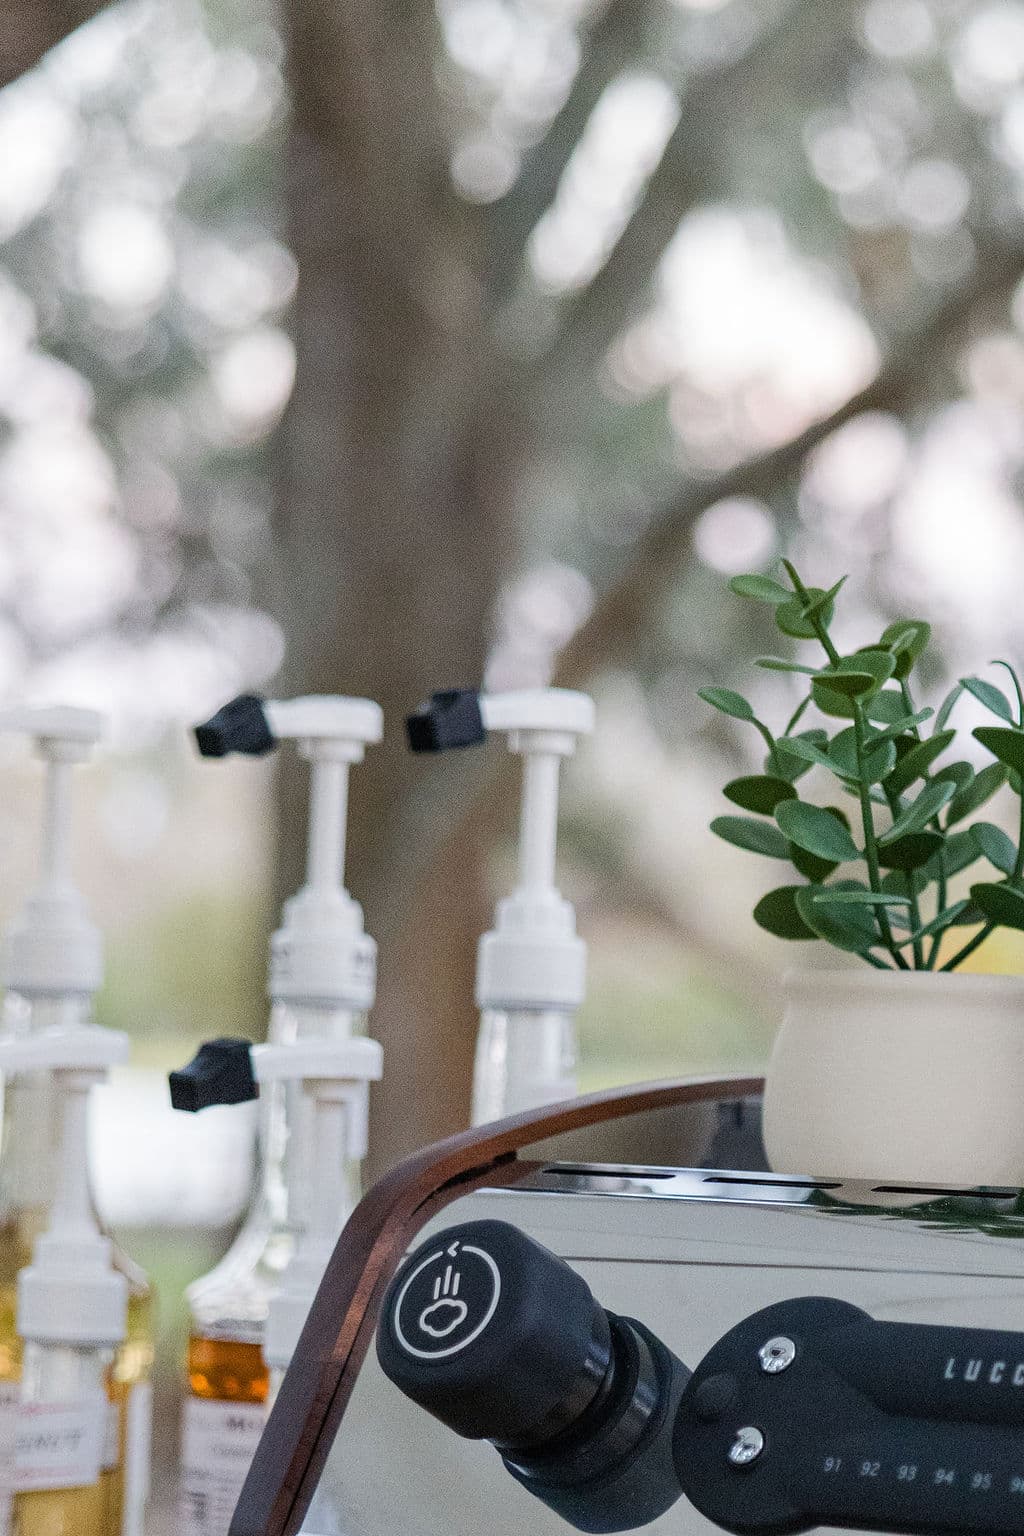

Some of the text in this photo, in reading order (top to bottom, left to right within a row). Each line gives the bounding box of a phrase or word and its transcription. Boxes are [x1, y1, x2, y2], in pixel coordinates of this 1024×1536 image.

[823, 1457, 842, 1472] 91
[861, 1461, 881, 1477] 92
[898, 1465, 917, 1481] 93
[934, 1468, 955, 1485] 94
[971, 1472, 993, 1490] 95
